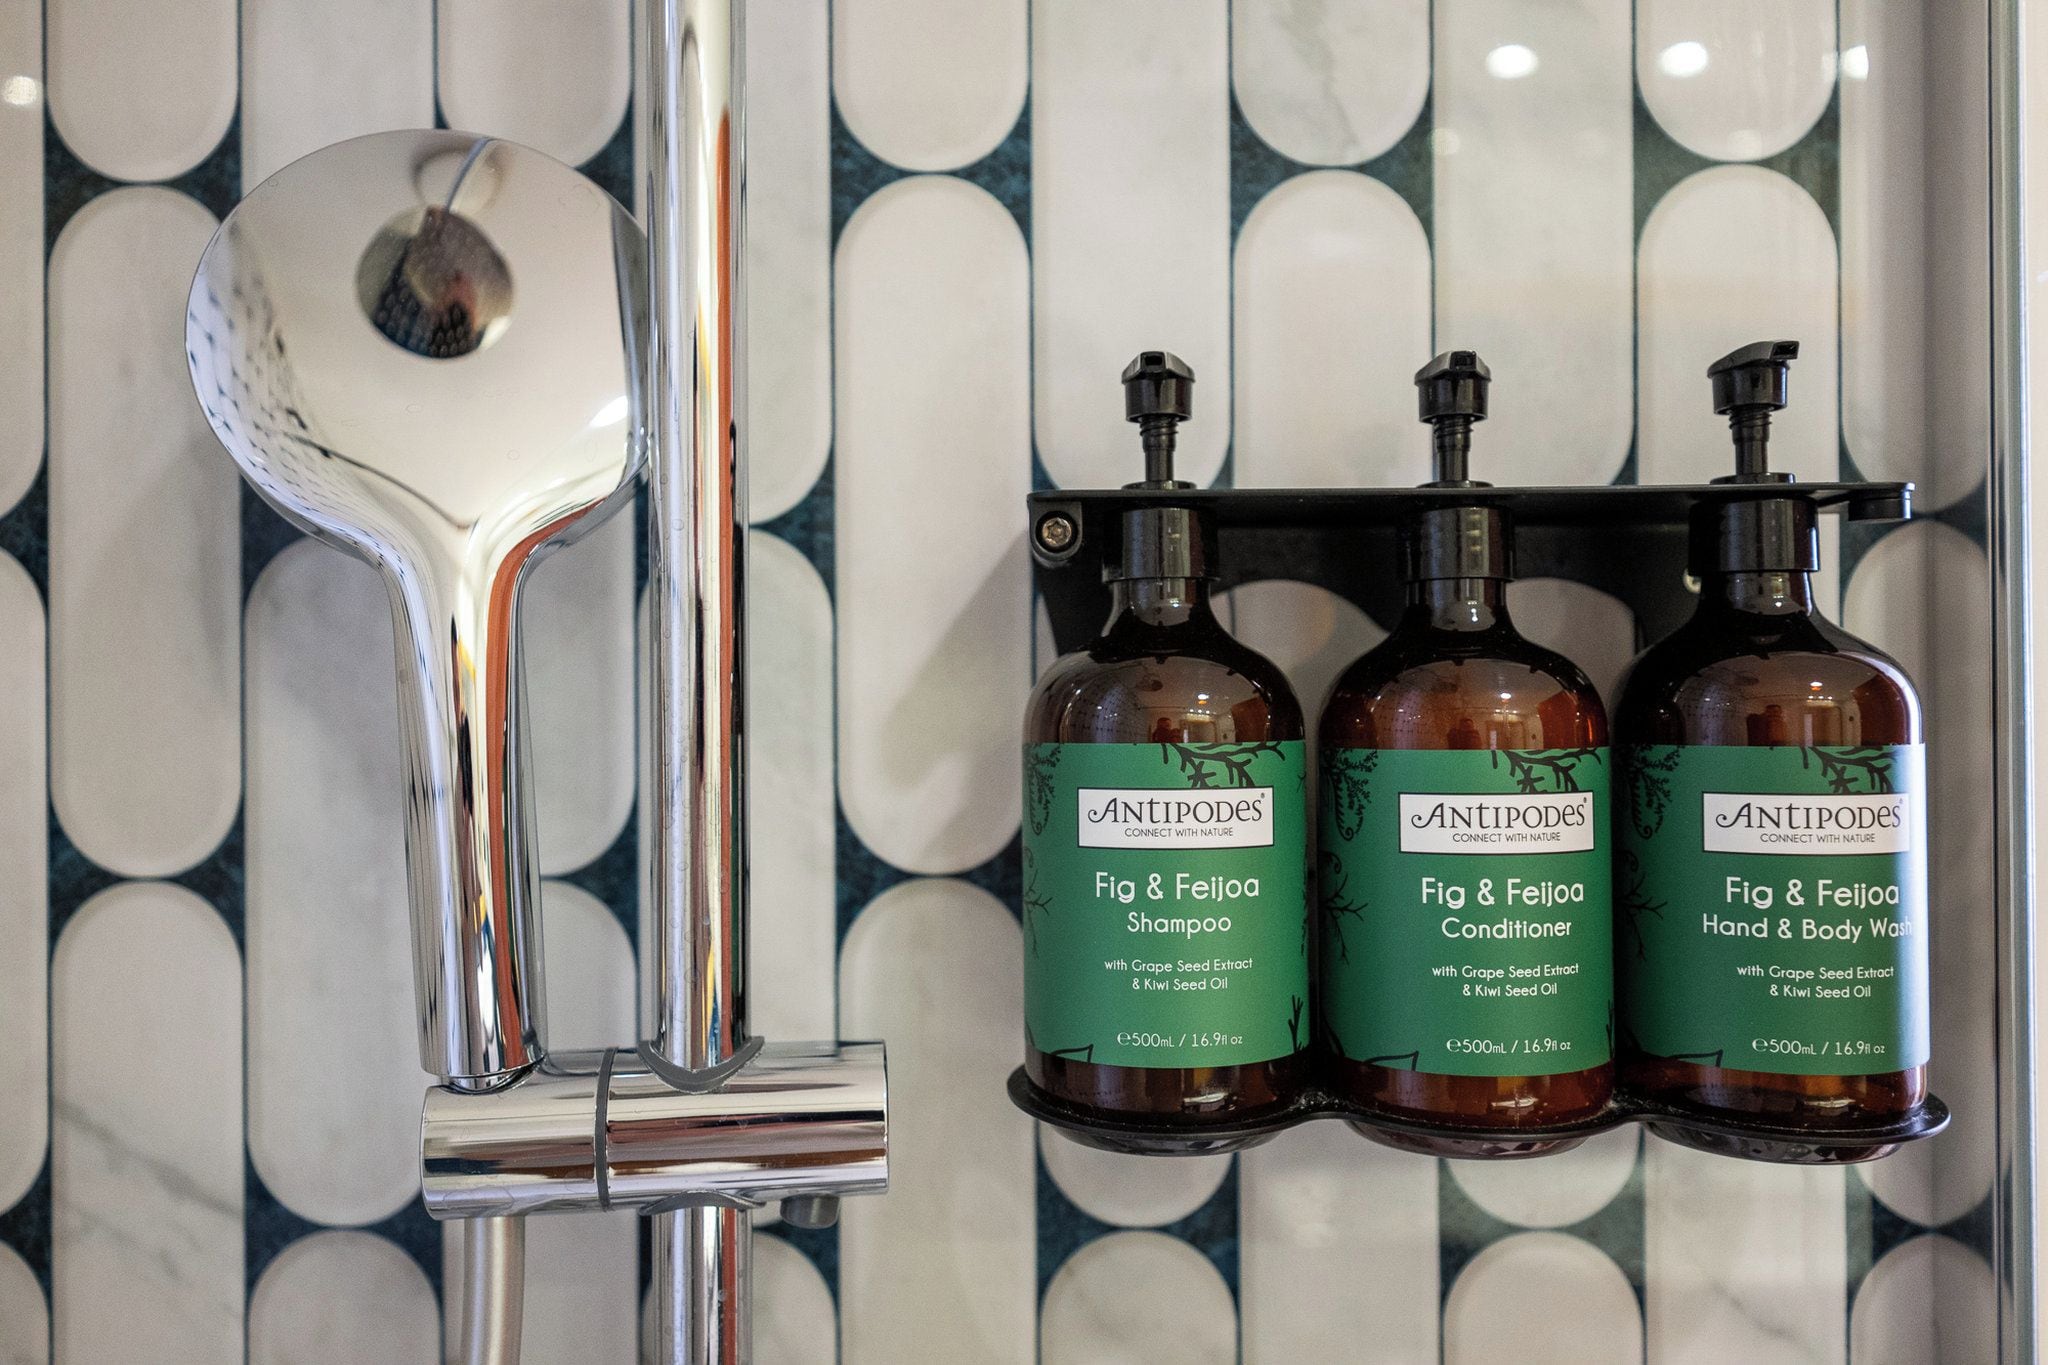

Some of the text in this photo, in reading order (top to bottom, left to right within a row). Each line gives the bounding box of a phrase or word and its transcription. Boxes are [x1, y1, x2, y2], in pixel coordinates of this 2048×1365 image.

[1124, 827, 1234, 838] CONNECT WITH NATURE
[1452, 831, 1561, 843] CONNECT WITH NATURE
[1760, 832, 1876, 844] CONNECT WITH NATURE
[1095, 871, 1260, 904] Fig & Feijoa
[1421, 877, 1584, 910] Fig & Feijoa
[1726, 876, 1900, 910] Fig & Feijoa
[1127, 912, 1232, 939] Shampoo
[1441, 917, 1572, 939] Conditioner
[1703, 913, 1912, 944] Hand & Body Wash
[1104, 958, 1253, 973] with Grape Seed Extract
[1431, 962, 1580, 981] with Grape Seed Extract
[1737, 965, 1894, 980] with Grape Seed Extract
[1132, 977, 1228, 990] & Kiwi Seed Oil
[1462, 983, 1558, 997] & Kiwi Seed Oil
[1769, 984, 1872, 998] & Kiwi Seed Oil
[1178, 1032, 1186, 1048] /
[1510, 1039, 1519, 1054] /
[1821, 1041, 1829, 1055] /
